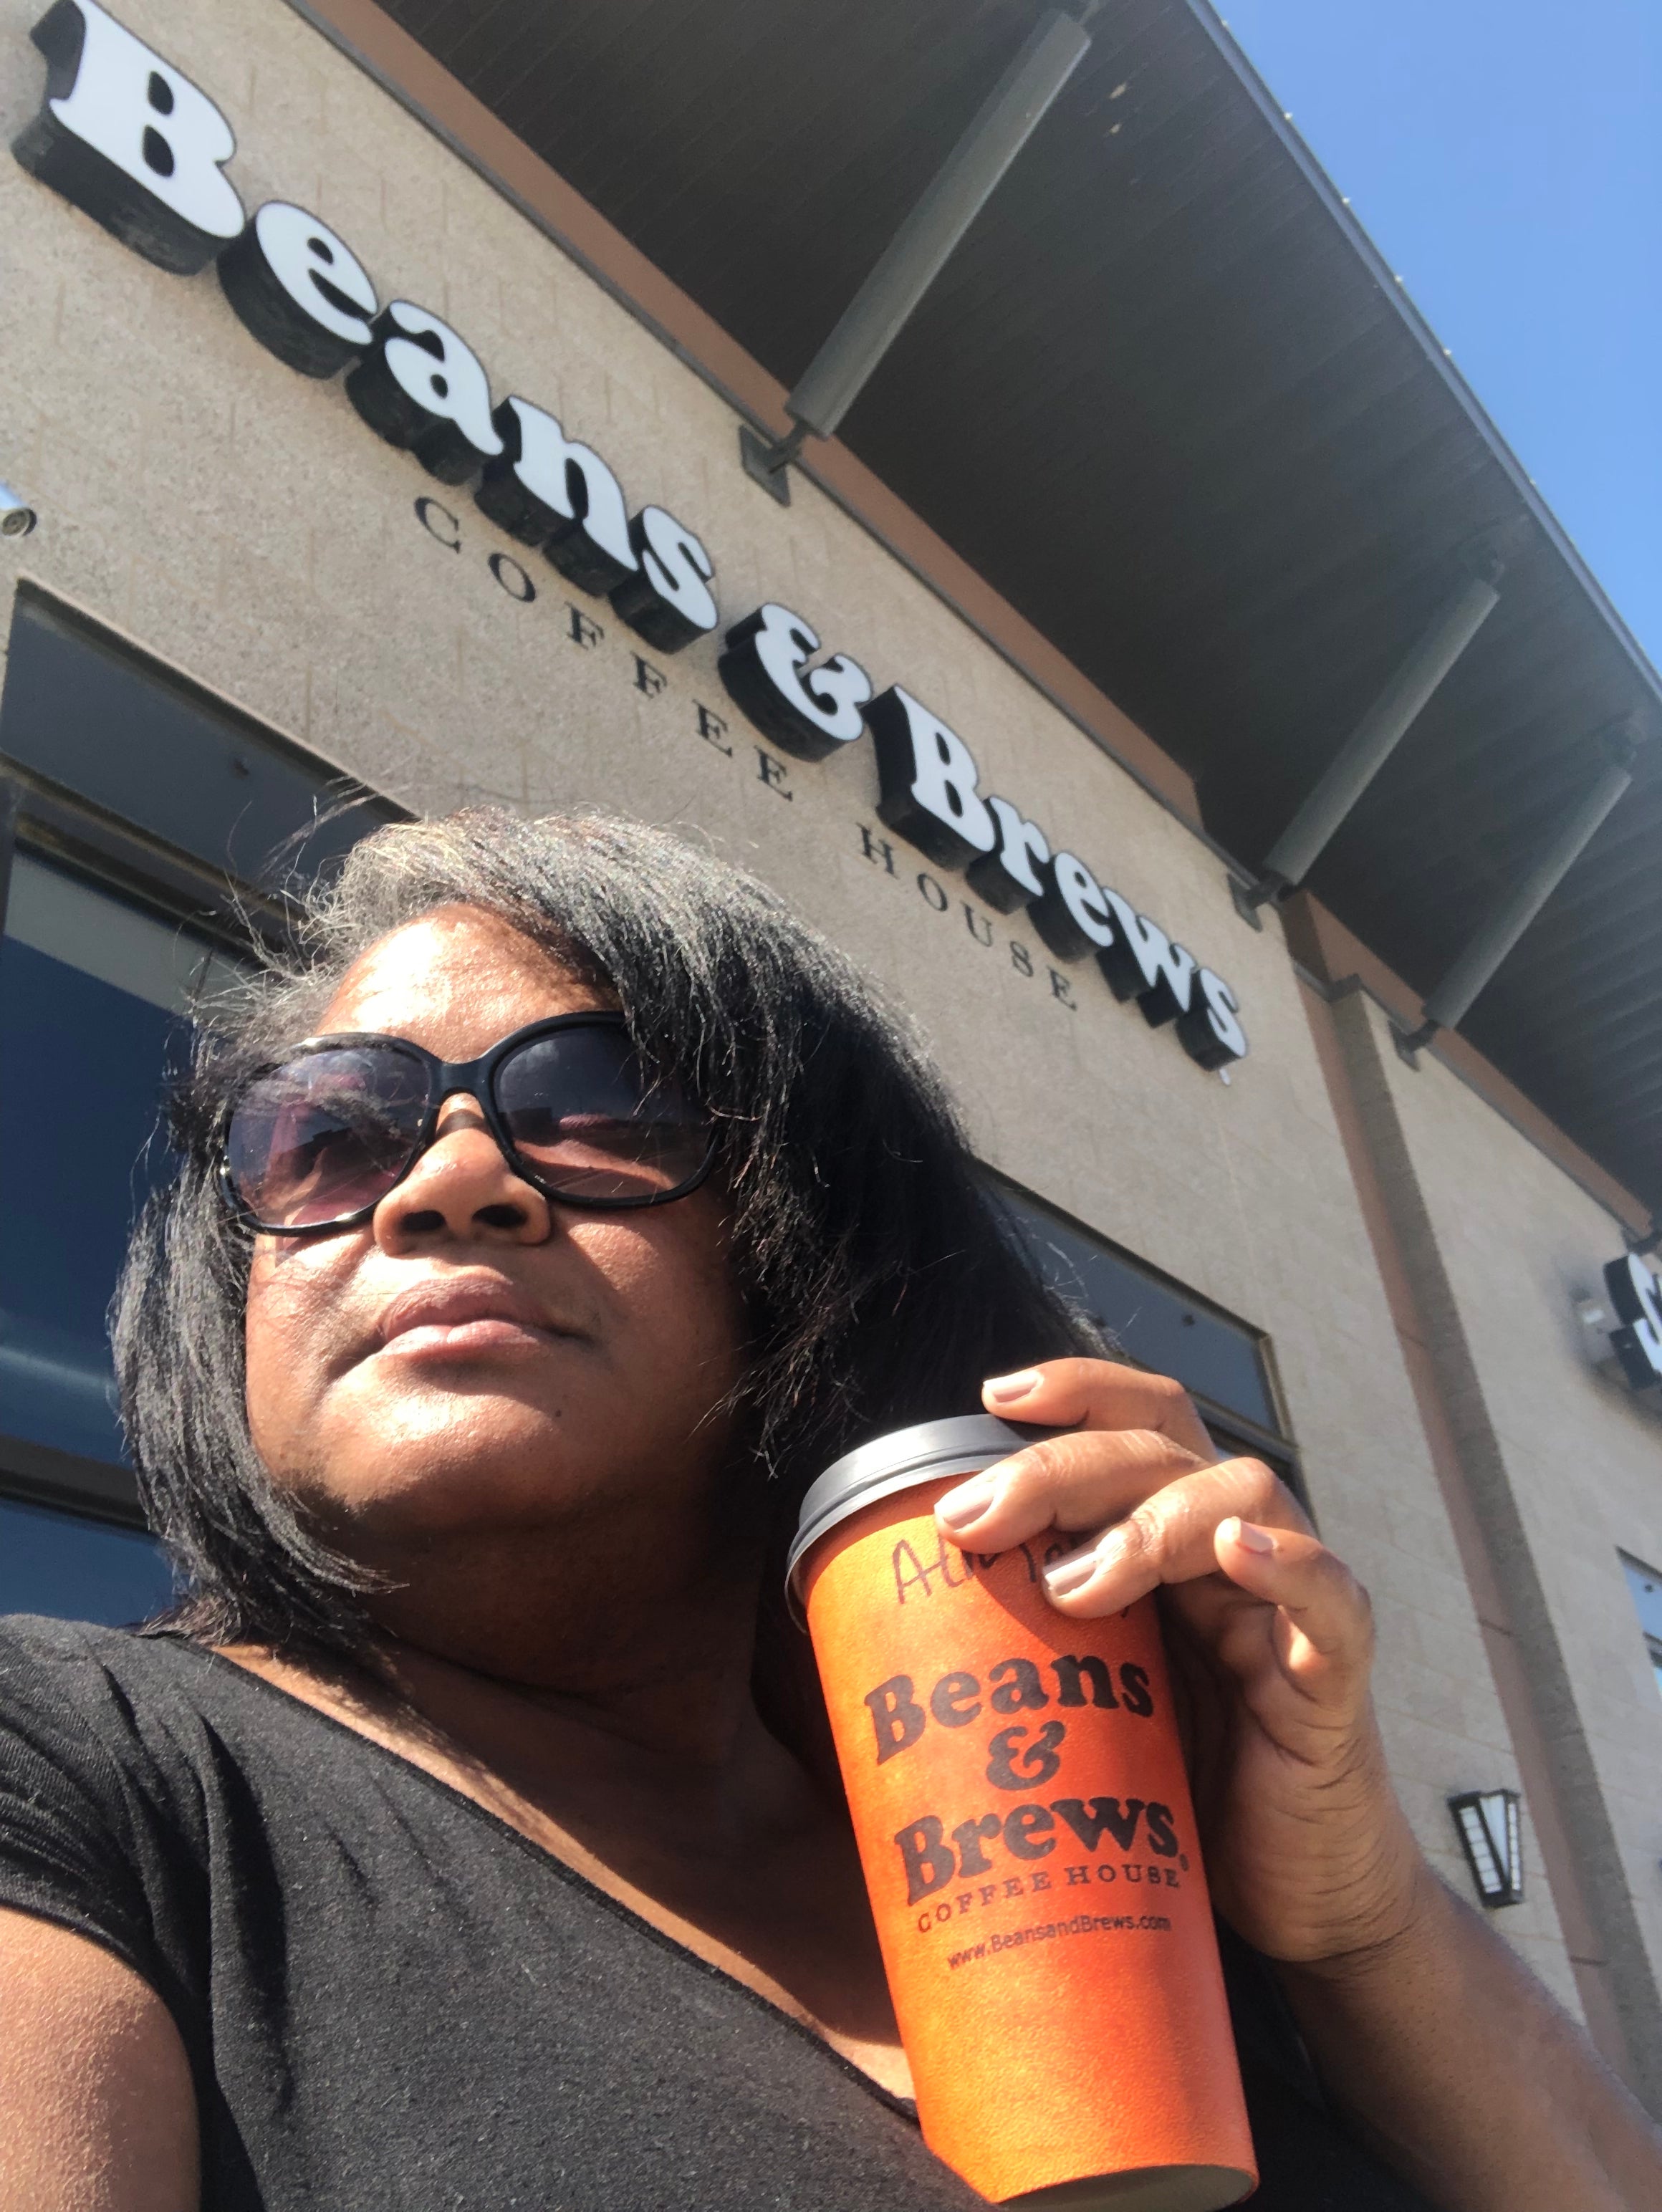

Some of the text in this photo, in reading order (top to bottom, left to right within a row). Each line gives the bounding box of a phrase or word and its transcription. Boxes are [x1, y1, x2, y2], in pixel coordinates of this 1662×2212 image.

[47, 0, 1247, 1059] Beans & Brews
[413, 495, 1077, 1011] COFFEE HOUSE
[864, 1654, 1155, 1766] Beans
[985, 1721, 1066, 1791] &
[894, 1797, 1181, 1907] Brews
[918, 1863, 1181, 1933] COFFEE HOUSE
[948, 1914, 1171, 1970] www.BeansandBrews.com
